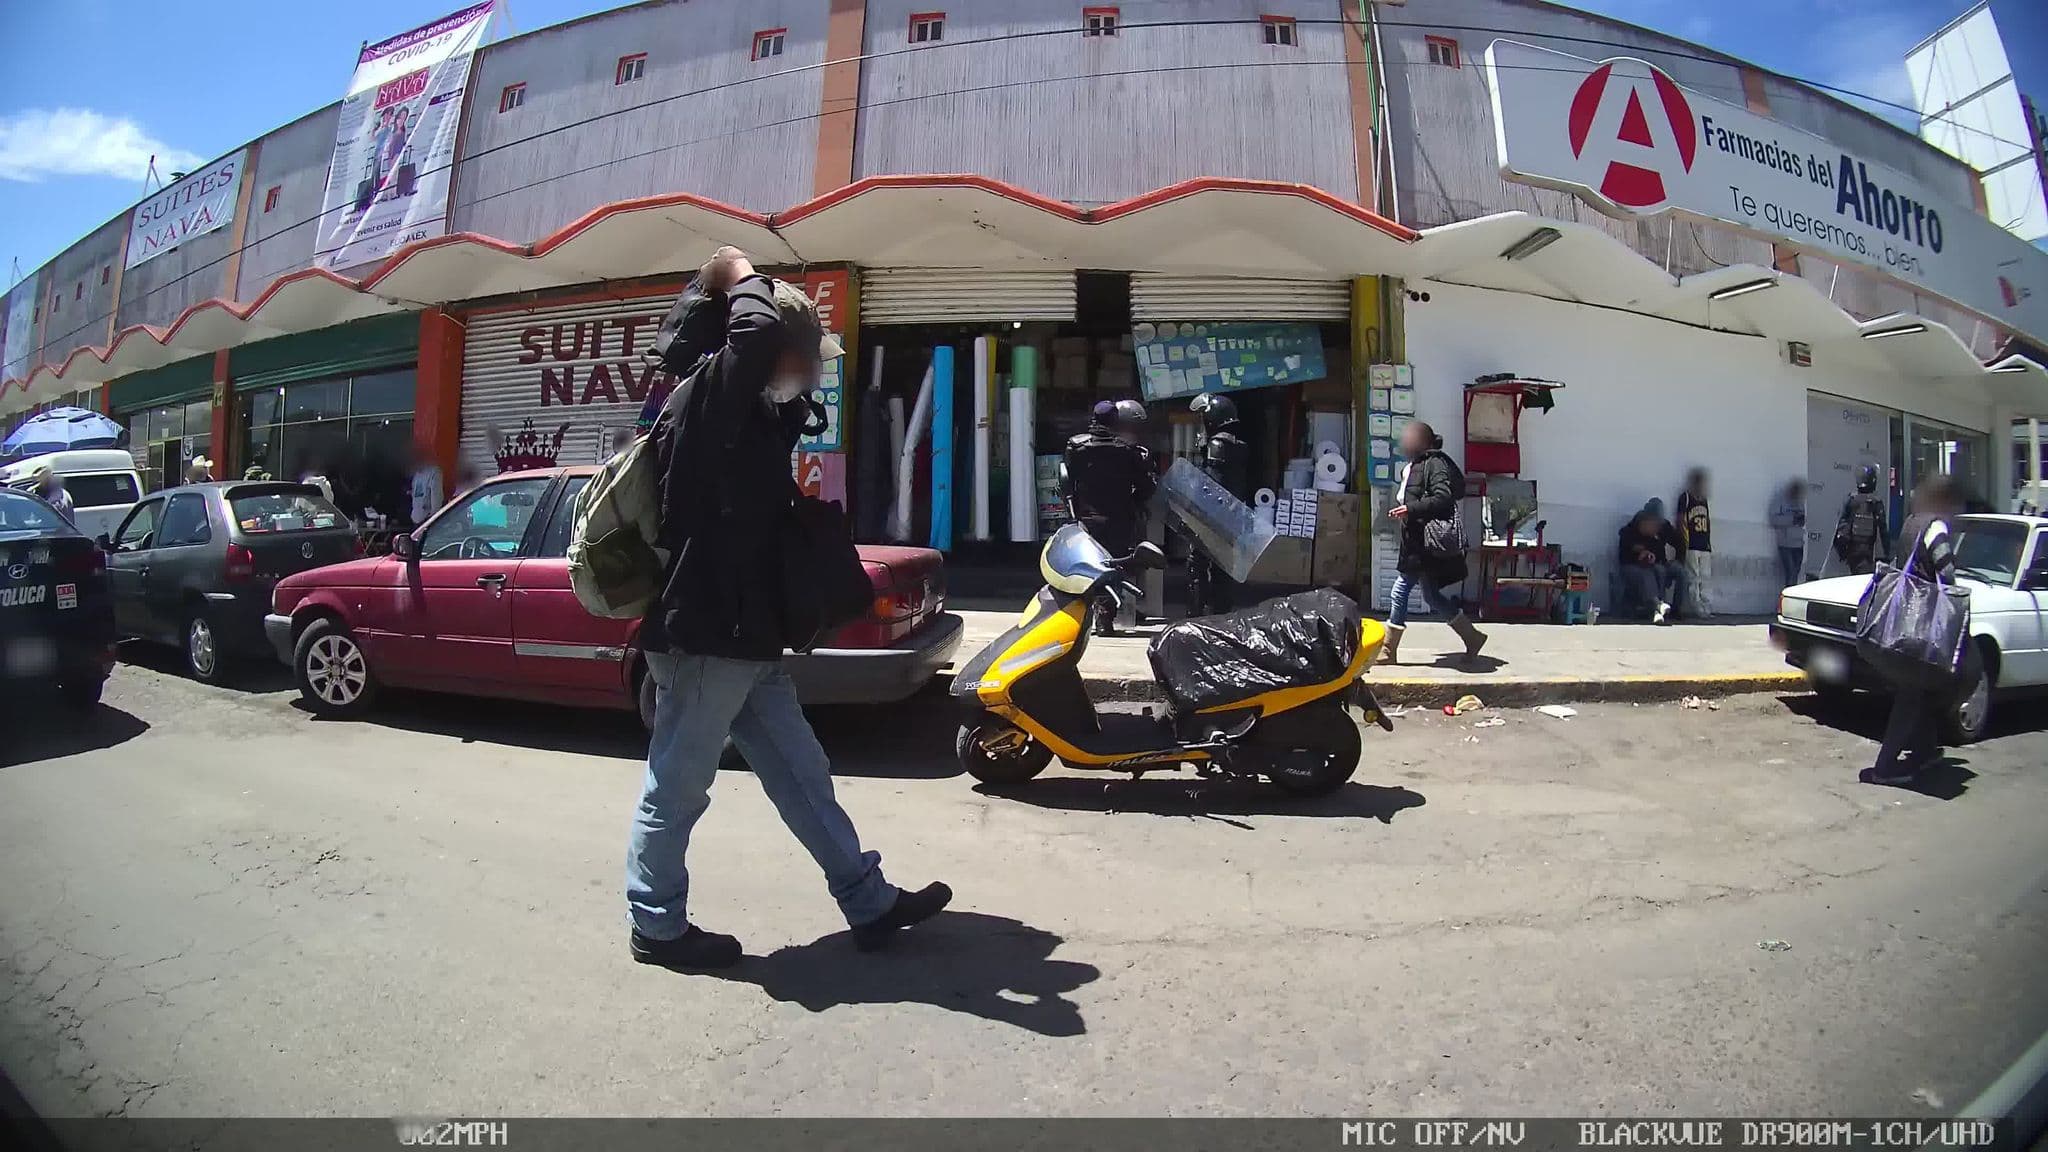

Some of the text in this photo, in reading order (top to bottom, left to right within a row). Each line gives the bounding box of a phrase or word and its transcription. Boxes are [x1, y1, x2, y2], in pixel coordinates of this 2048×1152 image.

[387, 32, 453, 66] COVID-19
[413, 28, 427, 39] de
[376, 70, 428, 105] NAVA
[138, 162, 235, 229] SUITES
[1701, 115, 1944, 254] Farmacias del Ahorro
[1729, 185, 1757, 217] Te
[141, 206, 213, 256] NAVA
[517, 314, 668, 364] SUIT
